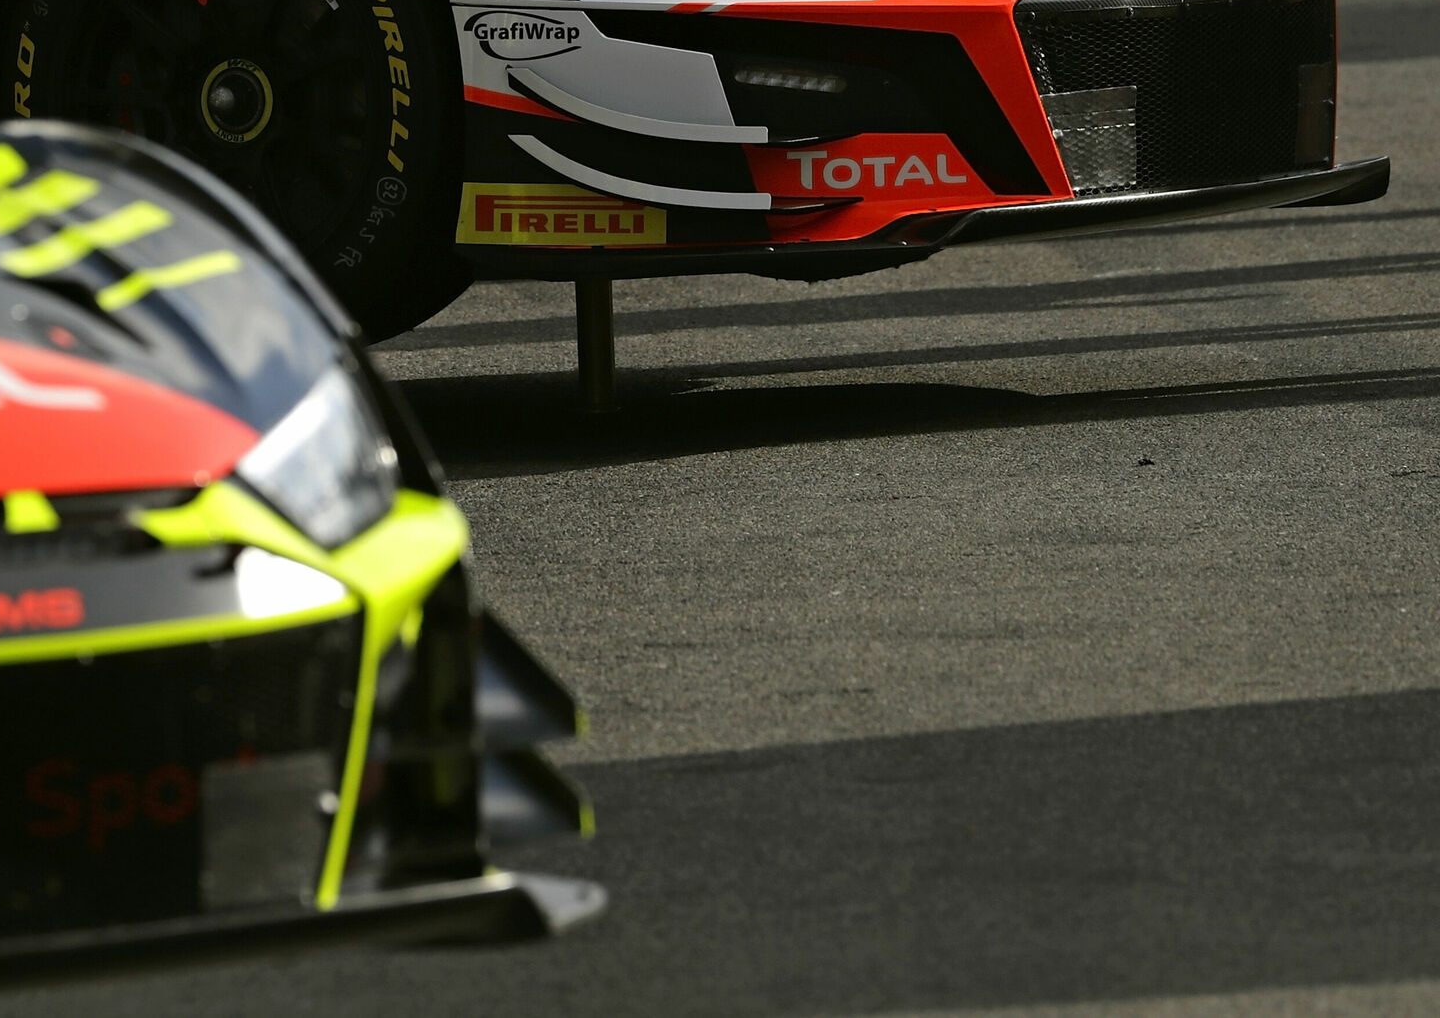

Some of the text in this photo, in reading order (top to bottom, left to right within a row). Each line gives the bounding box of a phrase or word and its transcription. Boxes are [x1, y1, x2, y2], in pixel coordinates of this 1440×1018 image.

[474, 22, 580, 44] GrafiWrap
[786, 150, 967, 190] TOTAL
[475, 194, 646, 234] PIRELLI
